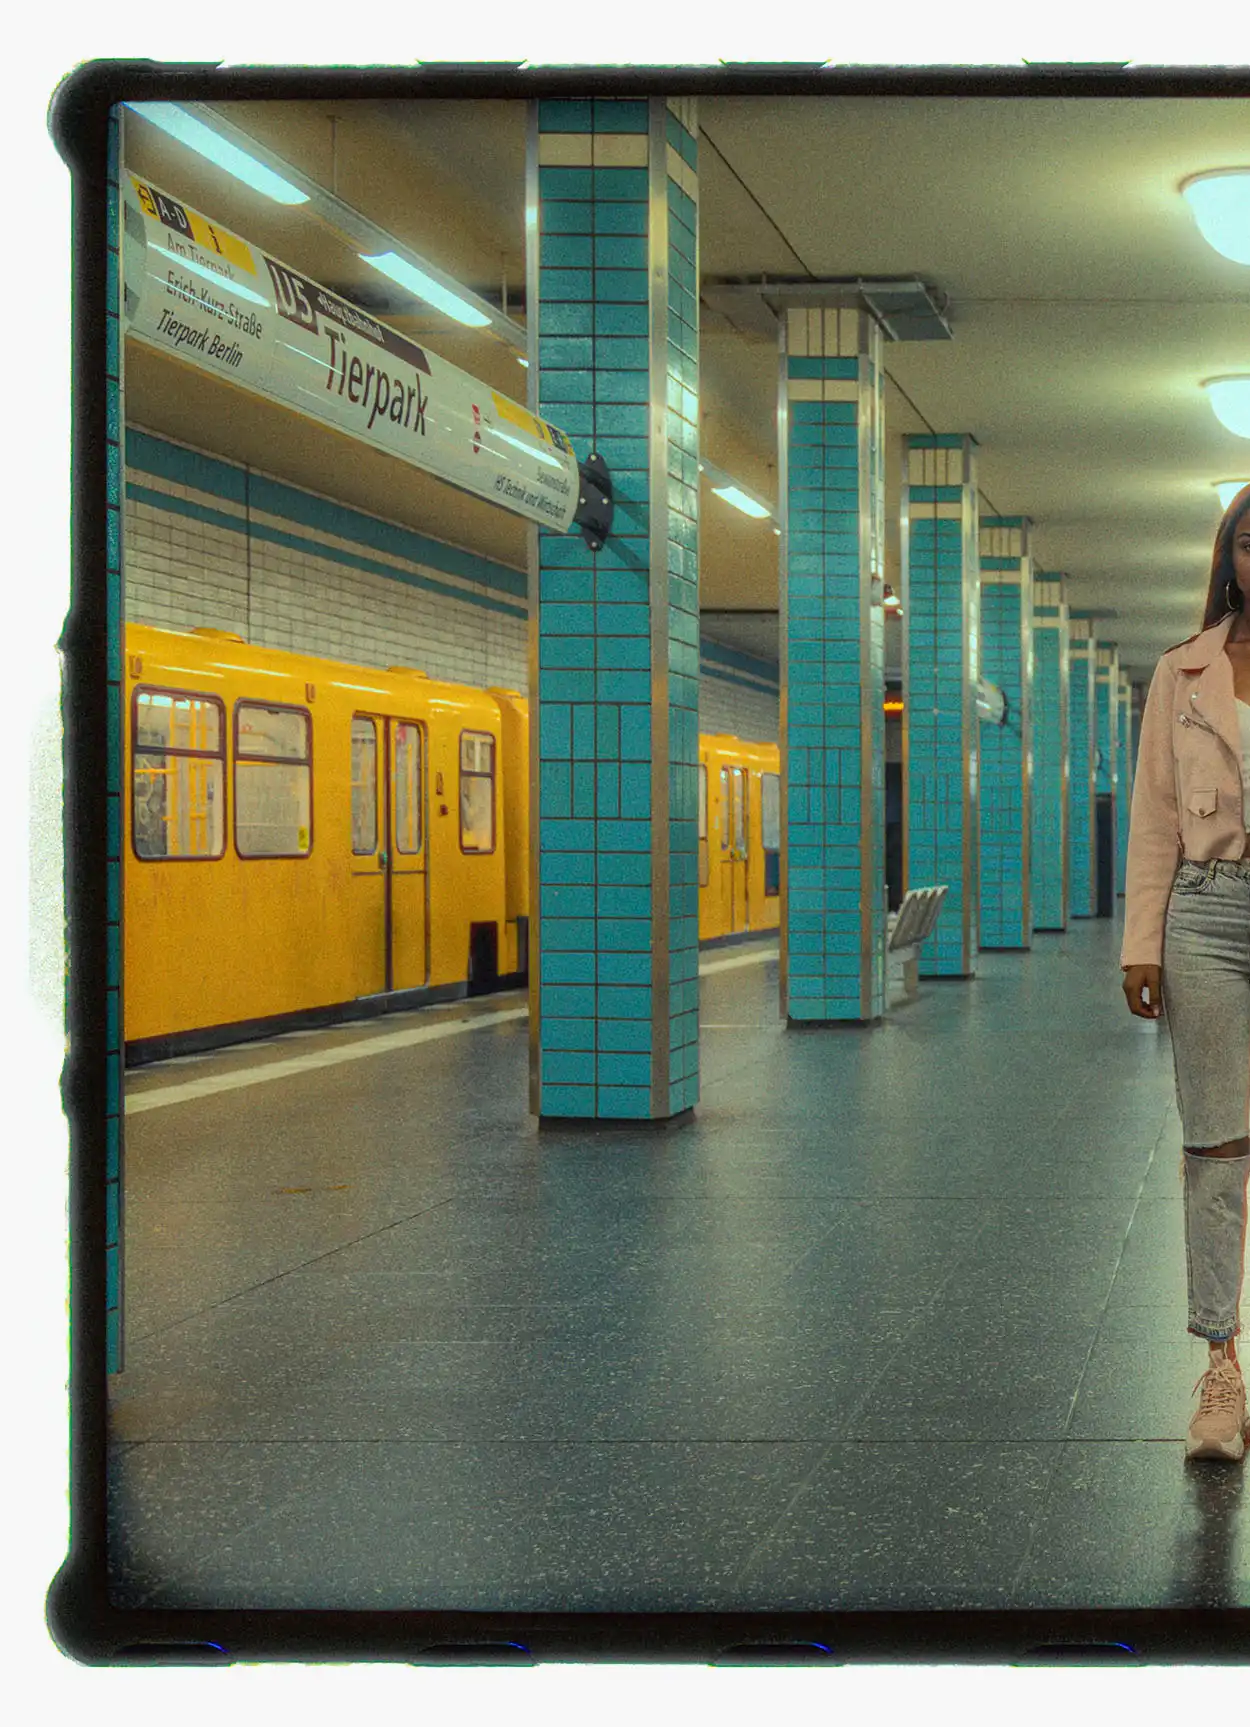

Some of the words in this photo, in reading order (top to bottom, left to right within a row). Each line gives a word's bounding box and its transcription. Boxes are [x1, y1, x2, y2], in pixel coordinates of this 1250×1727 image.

[270, 265, 313, 324] U5
[157, 308, 210, 351] Tierpark
[207, 334, 244, 368] Berlin
[324, 326, 429, 437] Tierpark
